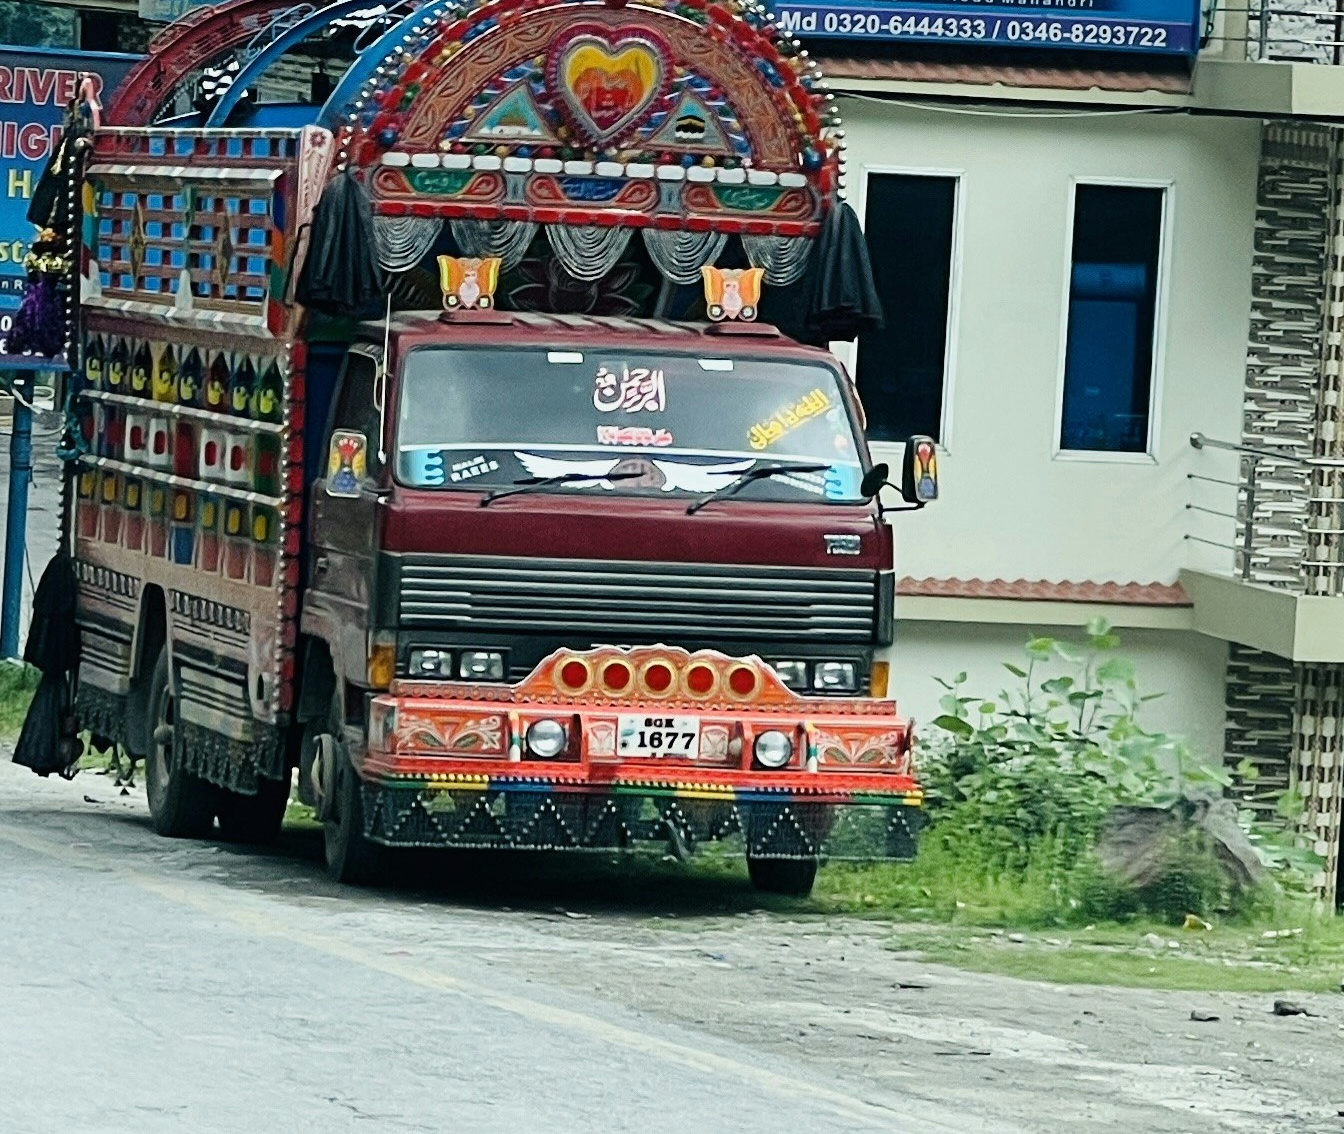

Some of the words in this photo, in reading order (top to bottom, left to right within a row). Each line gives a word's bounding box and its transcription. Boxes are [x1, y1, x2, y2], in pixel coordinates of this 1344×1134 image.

[781, 10, 818, 32] Md
[823, 11, 987, 40] 0320-6444333
[991, 19, 1002, 40] /
[1006, 20, 1169, 48] 0346-8293722
[637, 731, 696, 750] 1677
